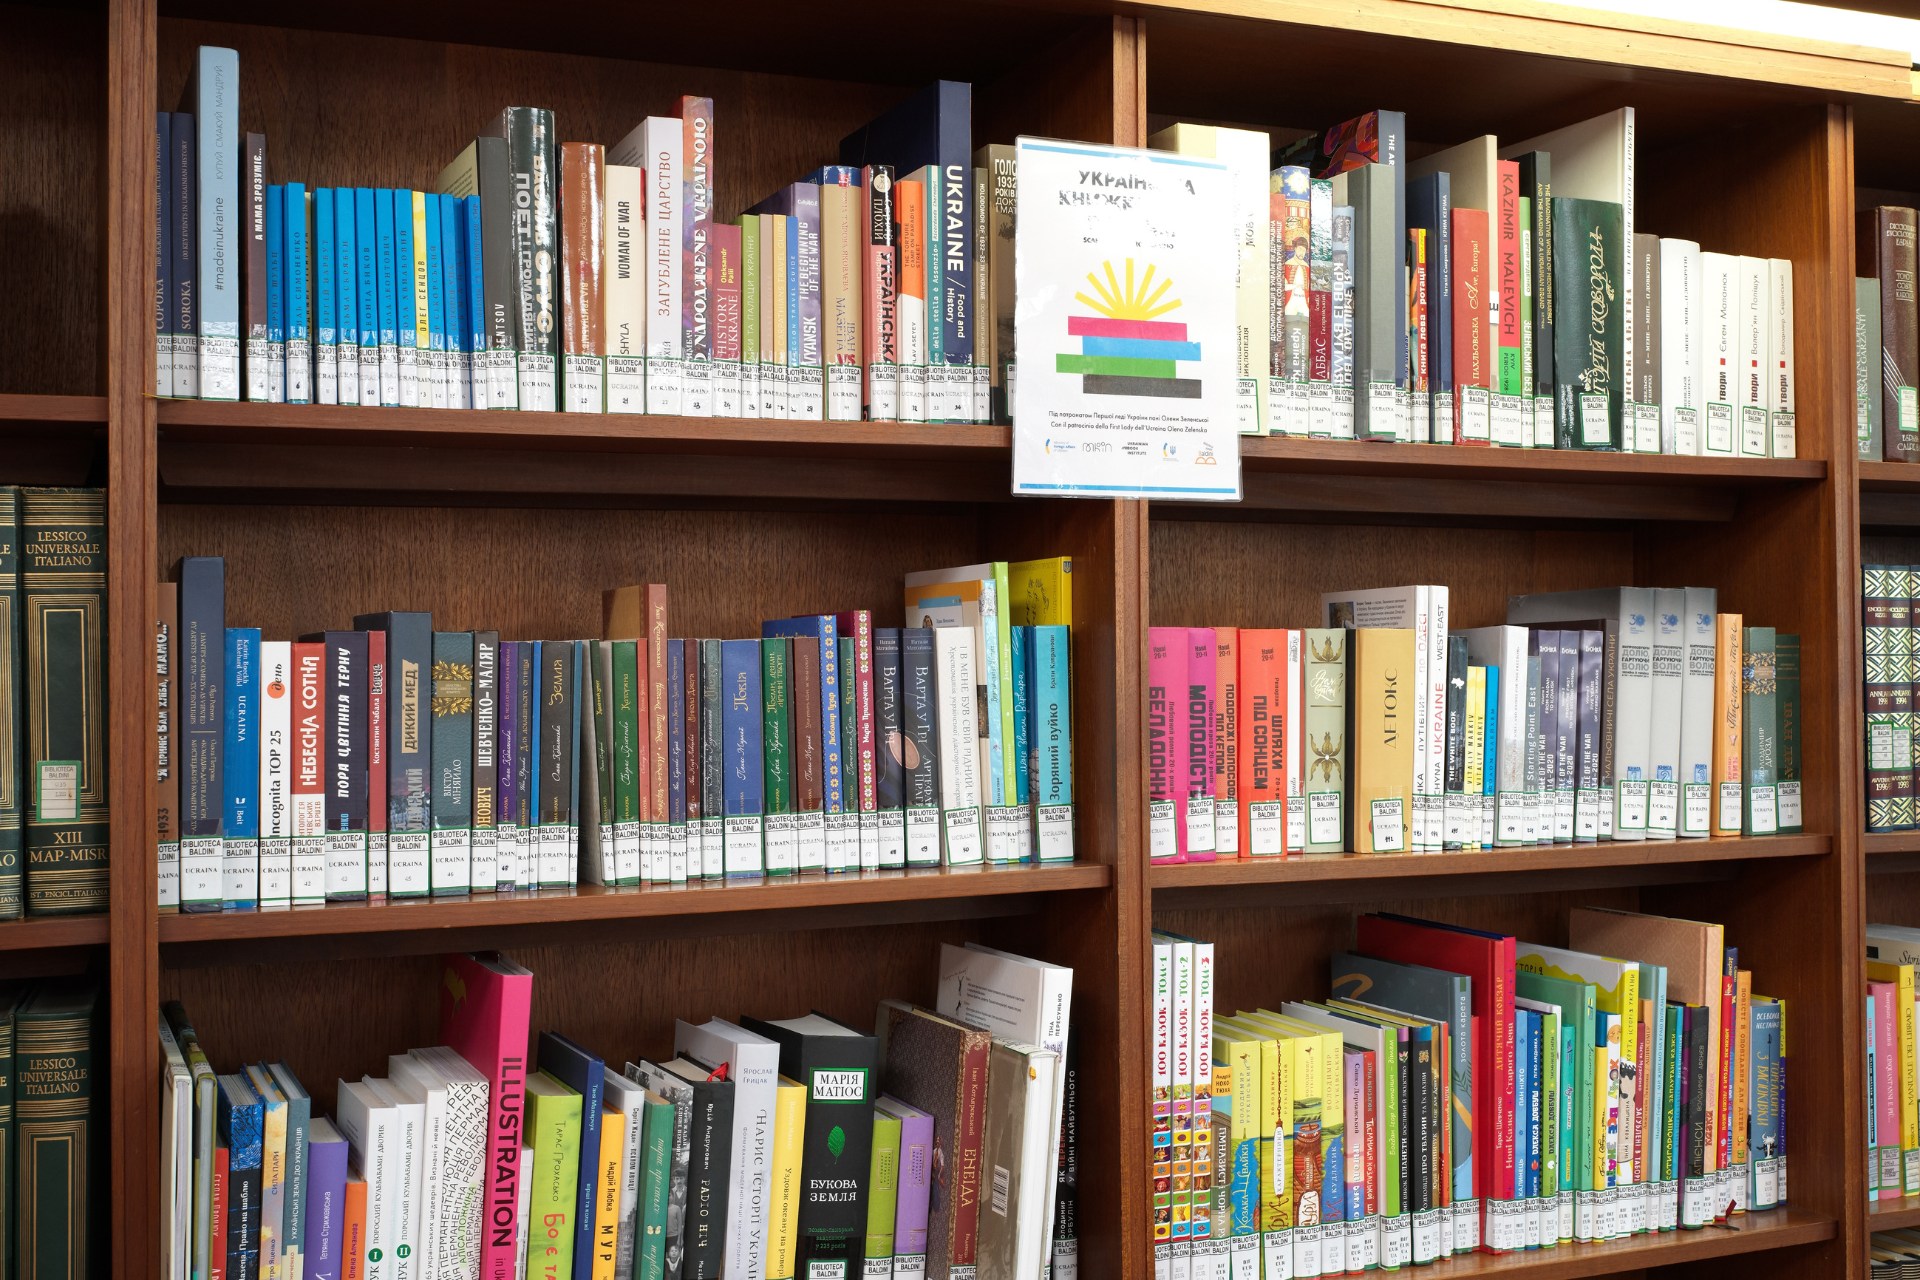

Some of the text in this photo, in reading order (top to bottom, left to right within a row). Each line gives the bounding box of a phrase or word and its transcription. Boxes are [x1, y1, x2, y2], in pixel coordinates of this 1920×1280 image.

[214, 65, 224, 180] КУПУЙ СМАКУЙ МАНДРУЙ
[255, 203, 263, 230] МАМА
[516, 173, 532, 233] ПОЕТ
[946, 165, 964, 272] UKRAINE
[212, 197, 225, 291] #madeinukraine
[618, 201, 630, 279] WOMAN OF WAR
[658, 151, 672, 317] ЗАГУБЛЕНЕ ЦАРСТВО
[1502, 173, 1515, 335] KAZIMIR MALEVICH
[799, 221, 809, 300] THE BEGINNING
[808, 233, 819, 292] OF THE WAR
[182, 280, 191, 330] SOROKA
[717, 294, 728, 355] HISTORY
[727, 294, 738, 355] UKRAINE
[946, 287, 956, 323] History
[957, 293, 966, 318] Food
[1419, 267, 1427, 375] книга лева ротації
[1720, 272, 1728, 353] Євген Маланюк
[620, 322, 630, 355] SHYLA
[957, 320, 966, 339] and
[1291, 327, 1302, 365] Країна
[1472, 316, 1480, 380] ПАХЛЬОВСЬКА
[1859, 314, 1867, 362] GARZANTI
[1315, 338, 1327, 379] АББАС
[1524, 320, 1533, 392] ЗЕЛЕНСЬКИЙ БЕЗ
[1720, 371, 1728, 401] твори
[1751, 373, 1759, 402] твори
[1780, 374, 1788, 403] твори
[1067, 422, 1095, 430] patrocinio
[1109, 423, 1121, 431] First
[1121, 424, 1134, 432] Lady
[26, 543, 100, 554] UNIVERSALE
[38, 531, 87, 542] LESSICO
[34, 556, 92, 567] ITALIANO
[479, 642, 494, 689] МАЛЯР
[548, 659, 564, 707] Земля
[1621, 662, 1650, 671] ВОЛЮ
[403, 669, 419, 750] ДИКИЙ МЕД
[733, 671, 749, 712] Повія
[1384, 668, 1398, 749] ДЕТОКС
[1605, 634, 1617, 779] МАЛЬОВНИЧІ СЕЛА УКРАЇНИ
[238, 695, 246, 743] UCRAINA
[301, 656, 320, 786] НЕБЕСНА СОТНЯ
[337, 647, 352, 798] ПОРА ЦВІТІННЯ ТЕРНУ
[1449, 710, 1457, 734] BOOK
[1527, 686, 1537, 782] Starting Point. East
[1784, 701, 1793, 741] ІВАН
[1047, 703, 1064, 801] Зоряний вуйко
[1253, 695, 1269, 790] ПІД СОНЦЕМ
[1272, 715, 1283, 770] ШЛЯХИ
[1765, 736, 1773, 768] ДРОЗД
[269, 730, 285, 837] Incognita TOP 25
[452, 759, 462, 805] МІНЯЙЛО
[30, 848, 107, 863] MAP-MISR
[53, 831, 83, 845] XIII
[182, 840, 222, 849] BIBLIOTECA
[1158, 1006, 1168, 1048] КАЗОК
[1178, 1008, 1189, 1049] КАЗОК
[1200, 1008, 1210, 1050] КАЗОК
[1496, 976, 1504, 1071] ДИТЯЧИЙ КОБЗАР
[1506, 1022, 1514, 1049] Лева
[1906, 1007, 1914, 1041] LIBRAIO
[19, 1068, 88, 1083] UNIVERSALE
[29, 1058, 76, 1070] LESSICO
[820, 1073, 859, 1086] МАРІЯ
[1157, 1051, 1168, 1077] 100
[1178, 1052, 1189, 1078] 100
[1199, 1052, 1209, 1078] 100
[1506, 1051, 1515, 1095] Старого
[1905, 1061, 1914, 1106] MANUALE
[26, 1082, 80, 1095] ITALIANO
[814, 1085, 863, 1098] МАТІОС
[1531, 1090, 1539, 1122] ДОВБУШ
[1769, 1060, 1780, 1118] ТОРЕАДОРИ
[492, 1057, 522, 1247] ILLUSTRATION
[750, 1109, 768, 1224] НАРИС ІСТОРІЇ
[1505, 1144, 1513, 1169] Нові
[401, 1198, 409, 1241] ПОРОСЛИЙ
[406, 1120, 414, 1150] ДВОРИК
[605, 1161, 617, 1212] Андрій Любка
[810, 1179, 858, 1189] БУКОВА
[810, 1192, 857, 1203] ЗЕМЛЯ
[960, 1148, 977, 1209] ЕНЕЇДА
[242, 1209, 248, 1221] на
[373, 1203, 382, 1245] ПОРОСЛИЙ
[698, 1178, 711, 1248] РАДІО НІЧ
[777, 1168, 793, 1278] Уздовж океану на ровері
[1218, 1193, 1227, 1225] ЧОРНА
[239, 1220, 248, 1251] Право
